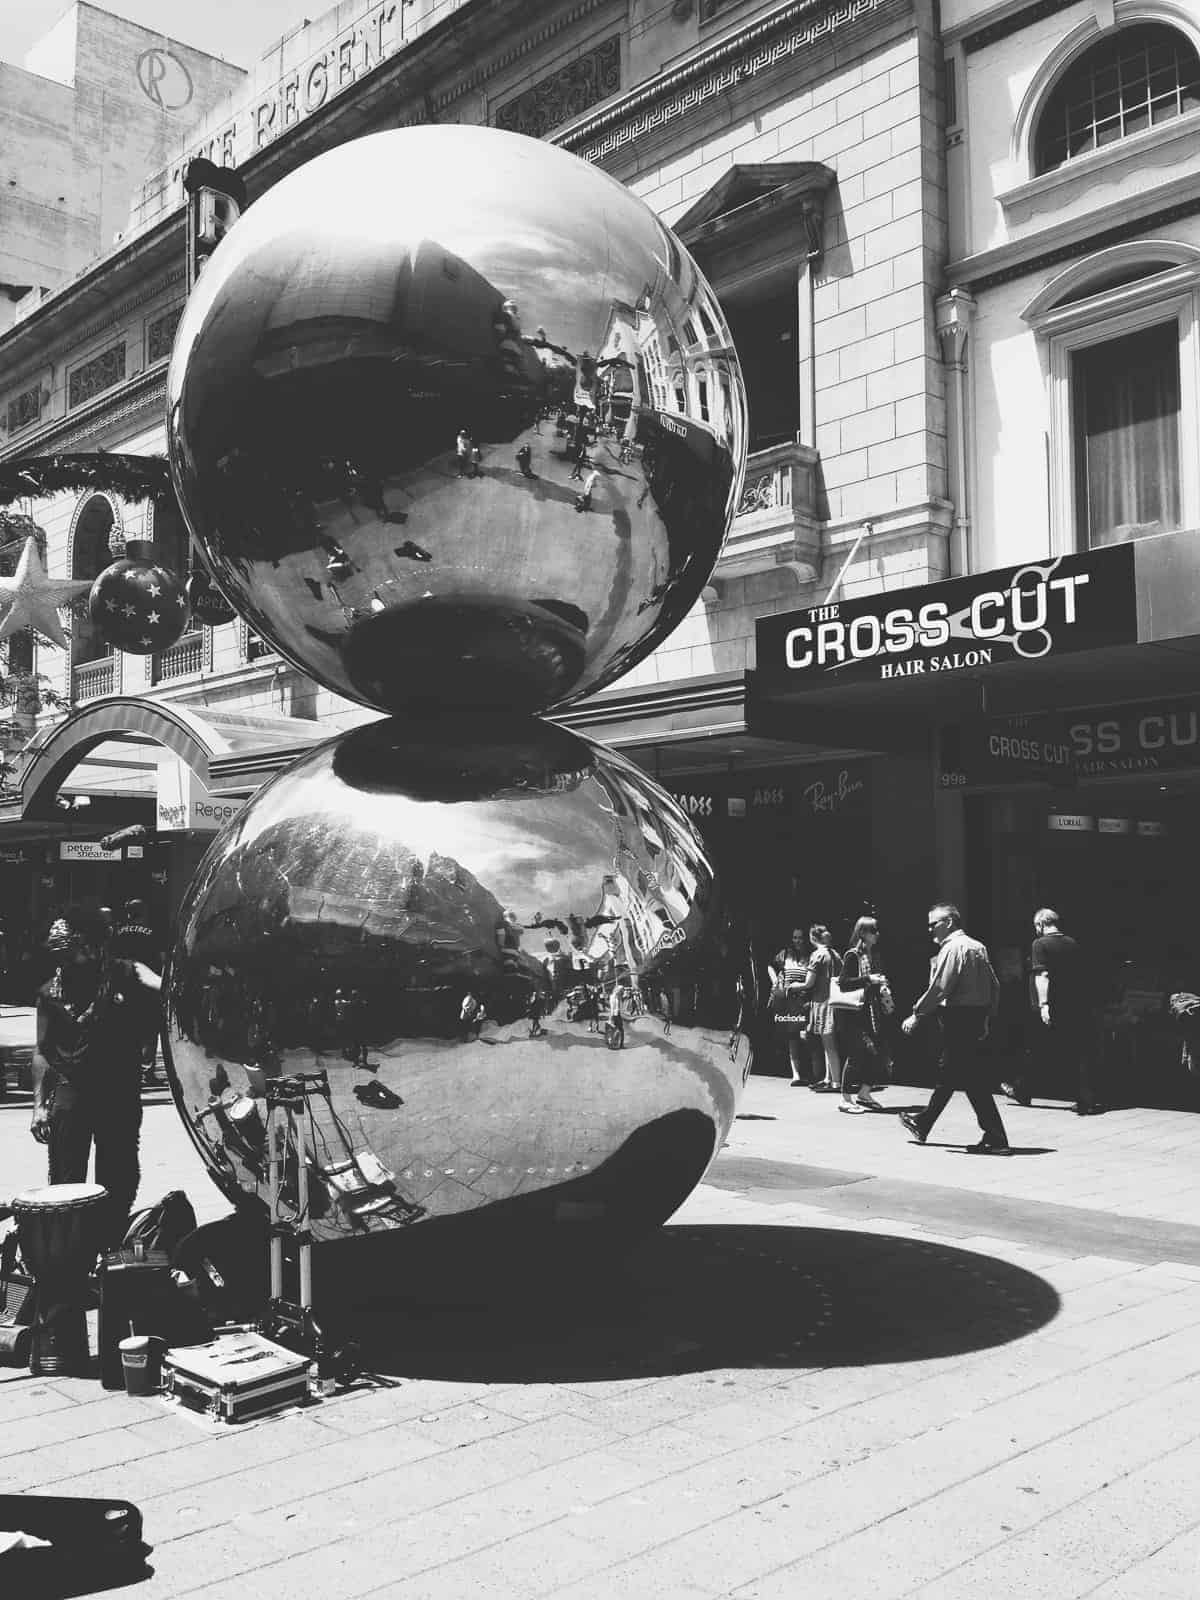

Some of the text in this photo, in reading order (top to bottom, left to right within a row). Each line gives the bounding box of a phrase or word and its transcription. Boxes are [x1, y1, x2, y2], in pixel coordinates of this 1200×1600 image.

[250, 0, 415, 147] REGENT
[785, 574, 1090, 670] CROSS CUT
[807, 604, 841, 624] THE
[880, 648, 993, 680] HAIR SALON
[989, 735, 1072, 766] CROSS CUT
